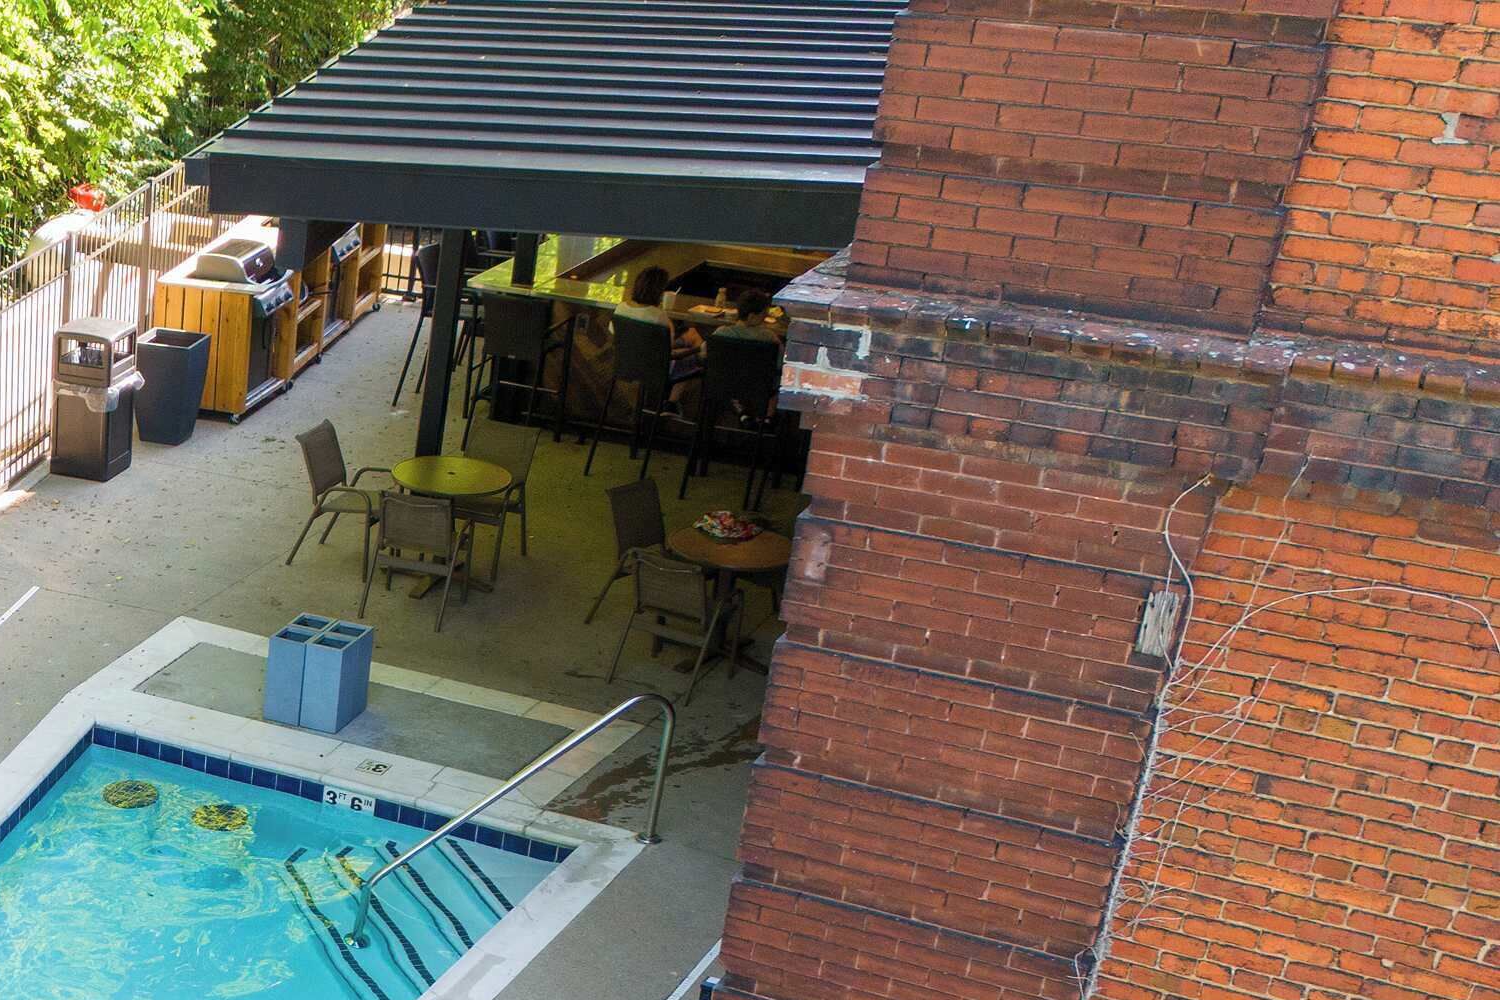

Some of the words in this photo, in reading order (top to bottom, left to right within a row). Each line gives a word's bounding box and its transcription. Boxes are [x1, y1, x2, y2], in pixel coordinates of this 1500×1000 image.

[325, 790, 338, 806] 3
[338, 792, 347, 800] FT
[350, 797, 363, 811] 6
